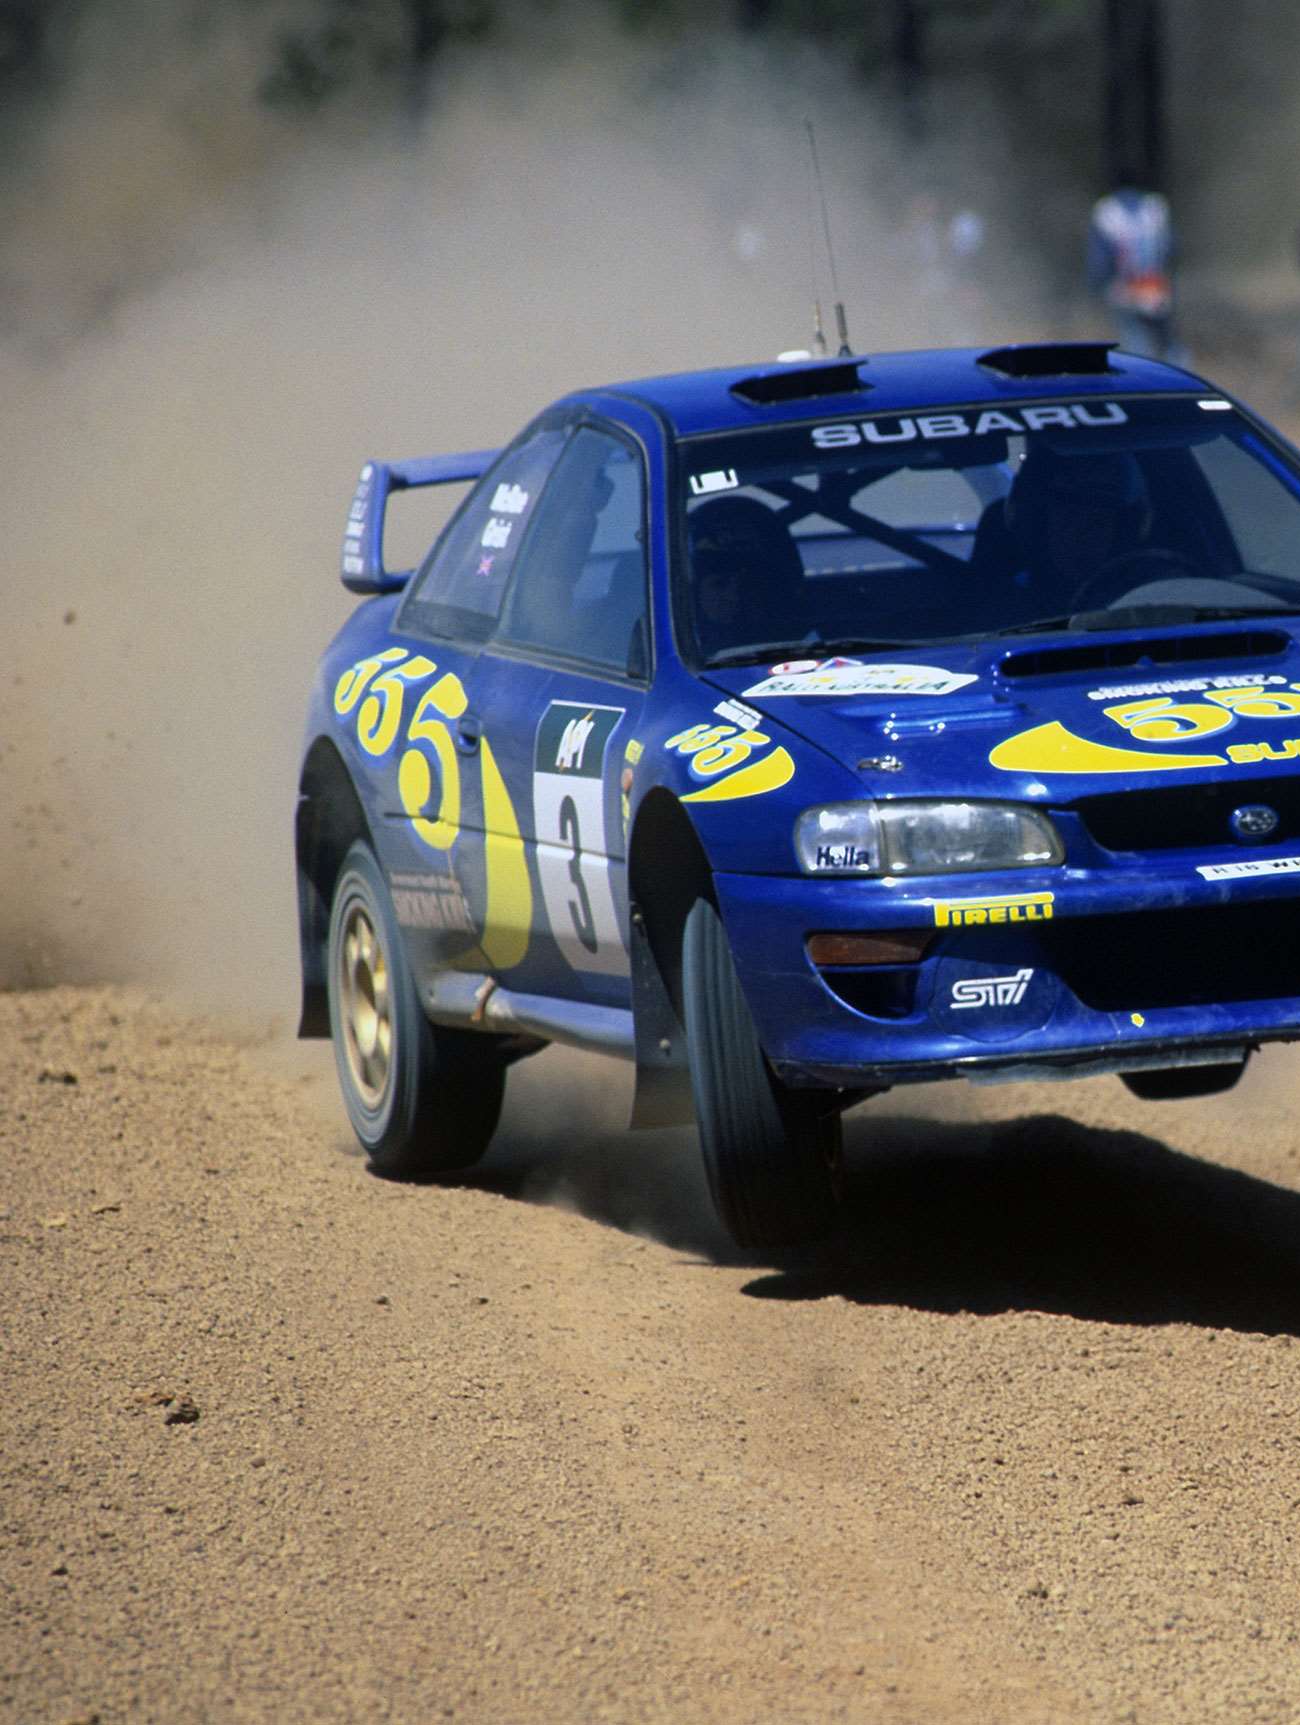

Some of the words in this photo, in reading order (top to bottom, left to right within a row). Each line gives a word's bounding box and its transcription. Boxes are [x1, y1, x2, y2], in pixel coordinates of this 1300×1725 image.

[811, 402, 1129, 448] SUBARU
[334, 647, 469, 850] 555
[559, 795, 598, 954] 3
[816, 846, 870, 867] Hella
[934, 891, 1055, 927] PIRELLI
